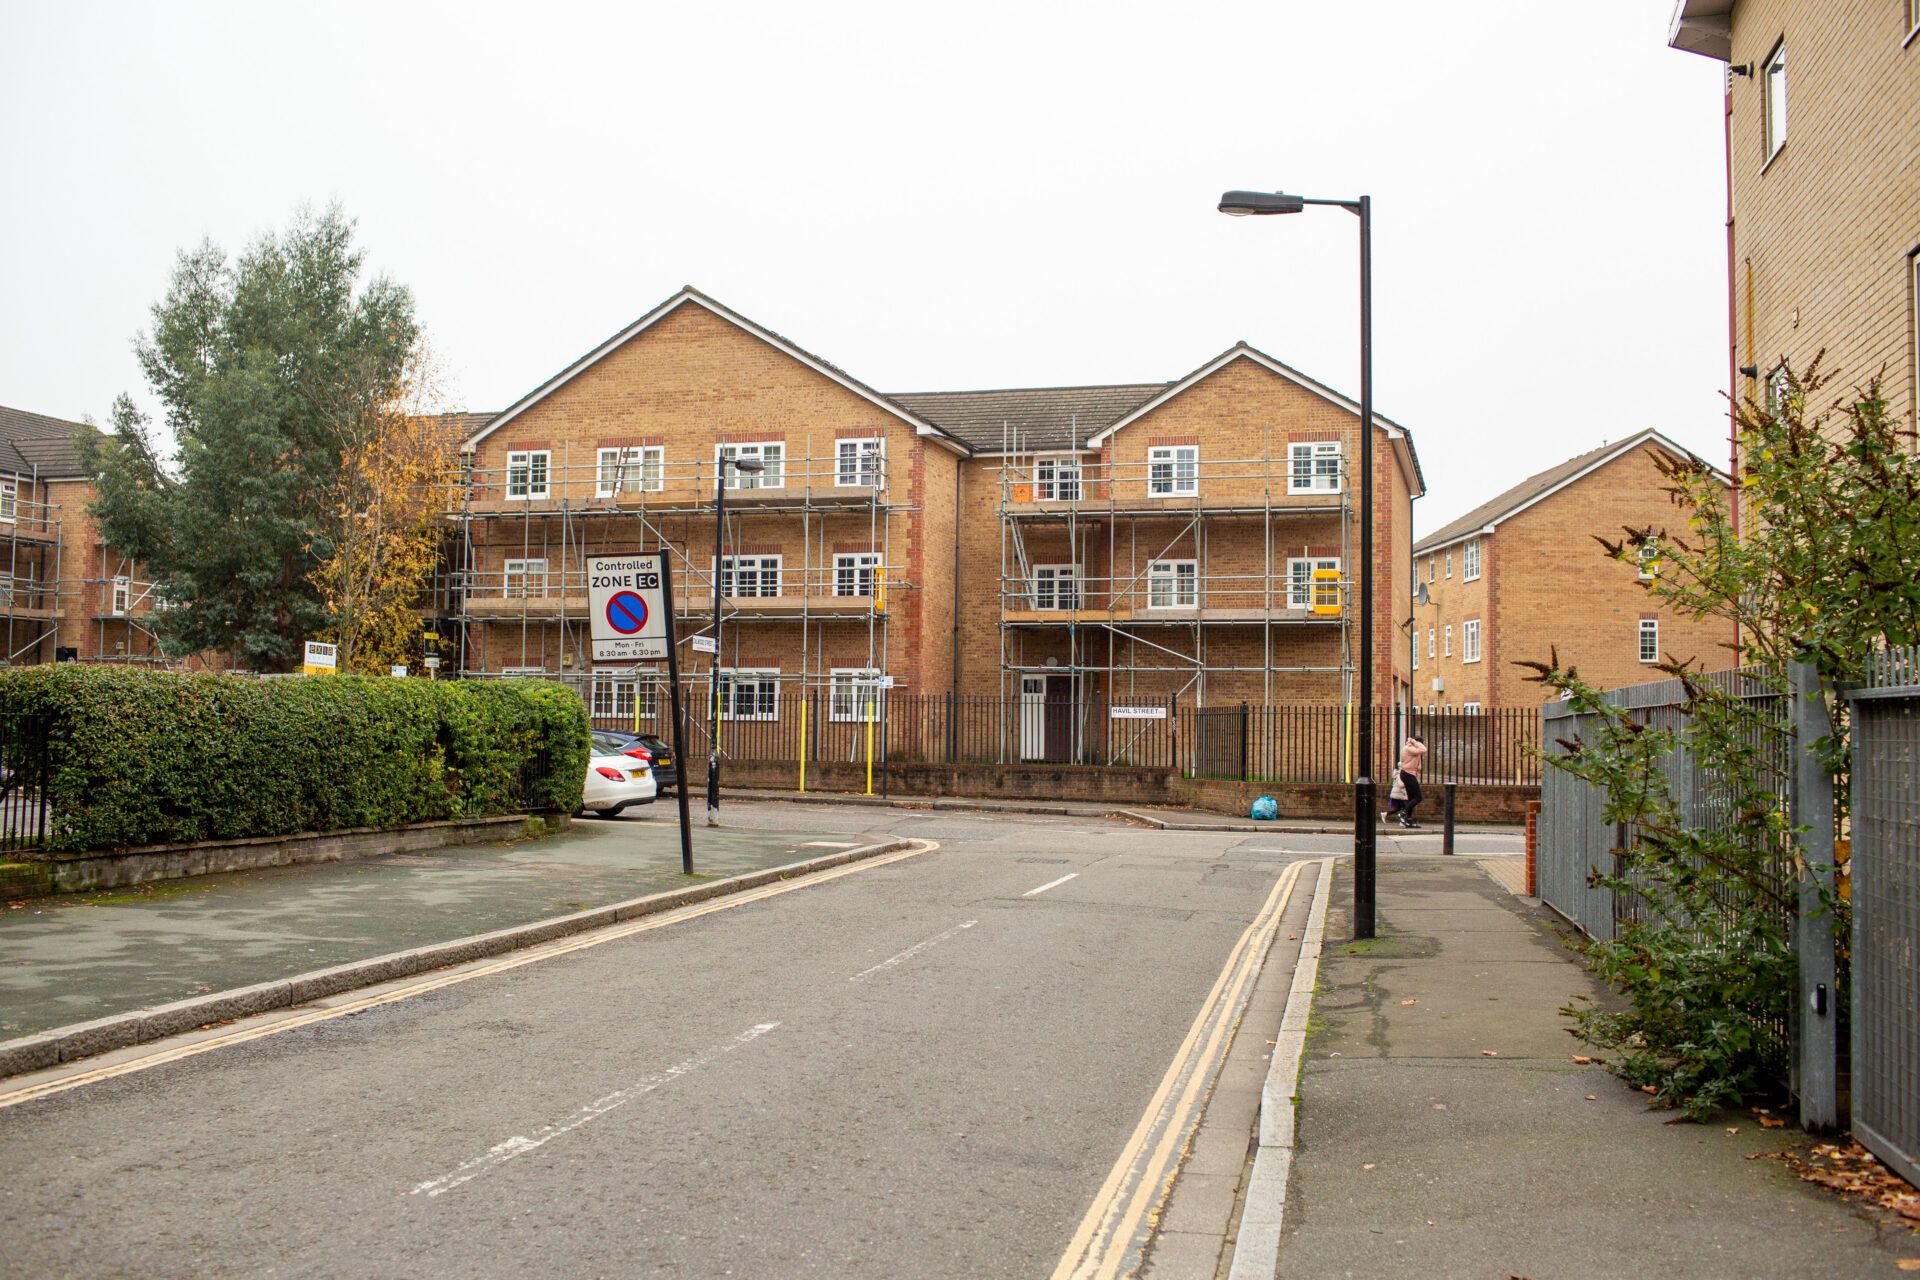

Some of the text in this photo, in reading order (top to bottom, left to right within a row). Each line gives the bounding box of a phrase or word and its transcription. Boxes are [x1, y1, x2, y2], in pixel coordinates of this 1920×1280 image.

[596, 560, 652, 571] Controlled
[592, 574, 658, 588] ZONE EC
